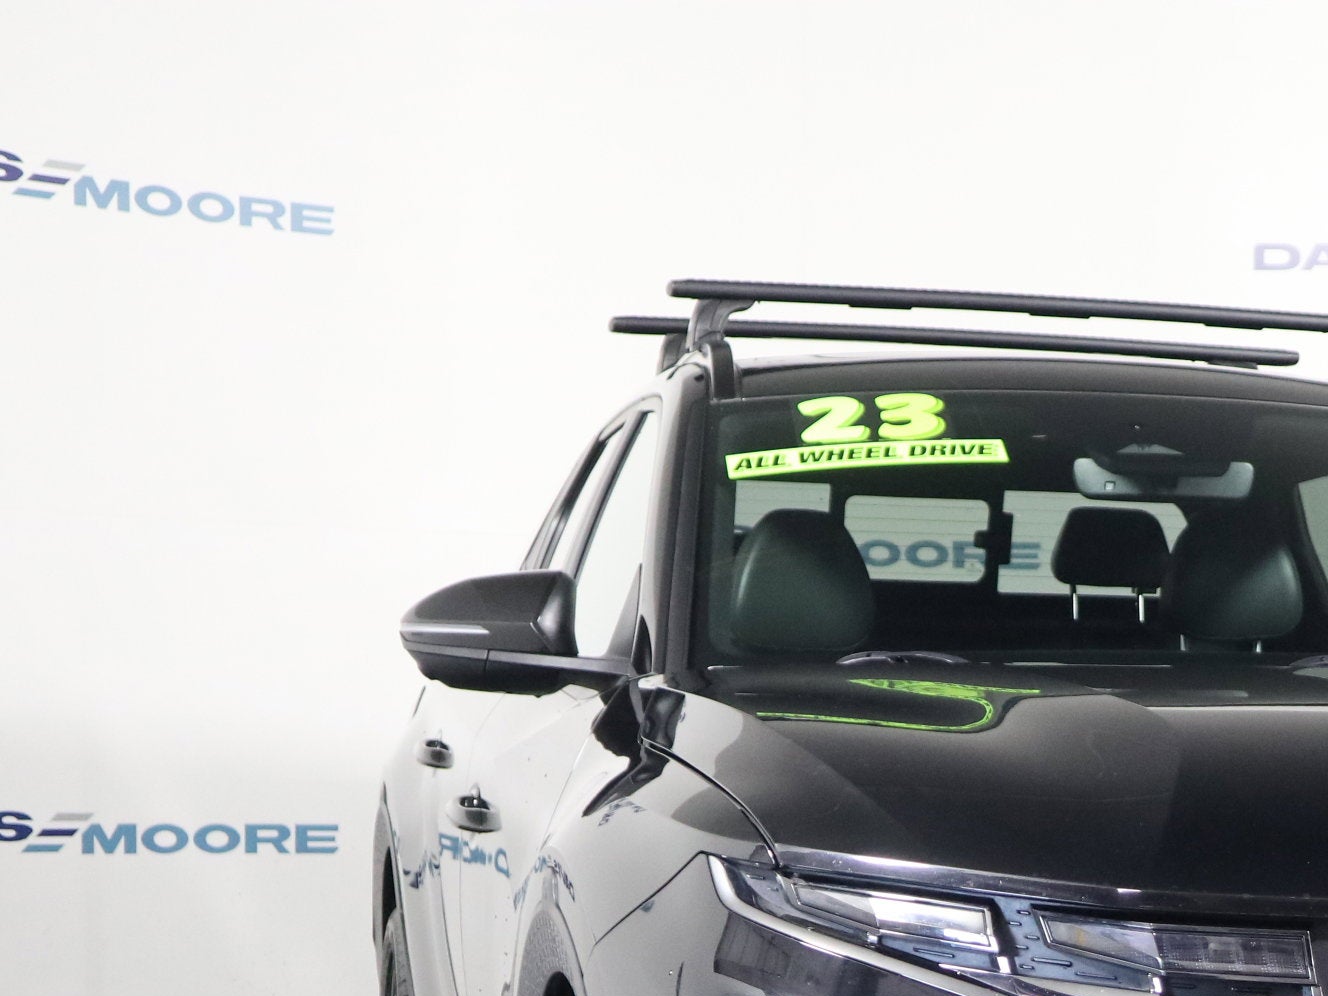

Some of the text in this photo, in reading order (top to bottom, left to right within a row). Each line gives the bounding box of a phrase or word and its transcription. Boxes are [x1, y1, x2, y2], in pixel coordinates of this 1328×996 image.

[74, 175, 335, 236] MOORE
[797, 392, 946, 443] 23
[733, 443, 993, 471] ALL WHEEL DRIVE
[859, 539, 1041, 571] OORE
[81, 823, 339, 854] MOORE
